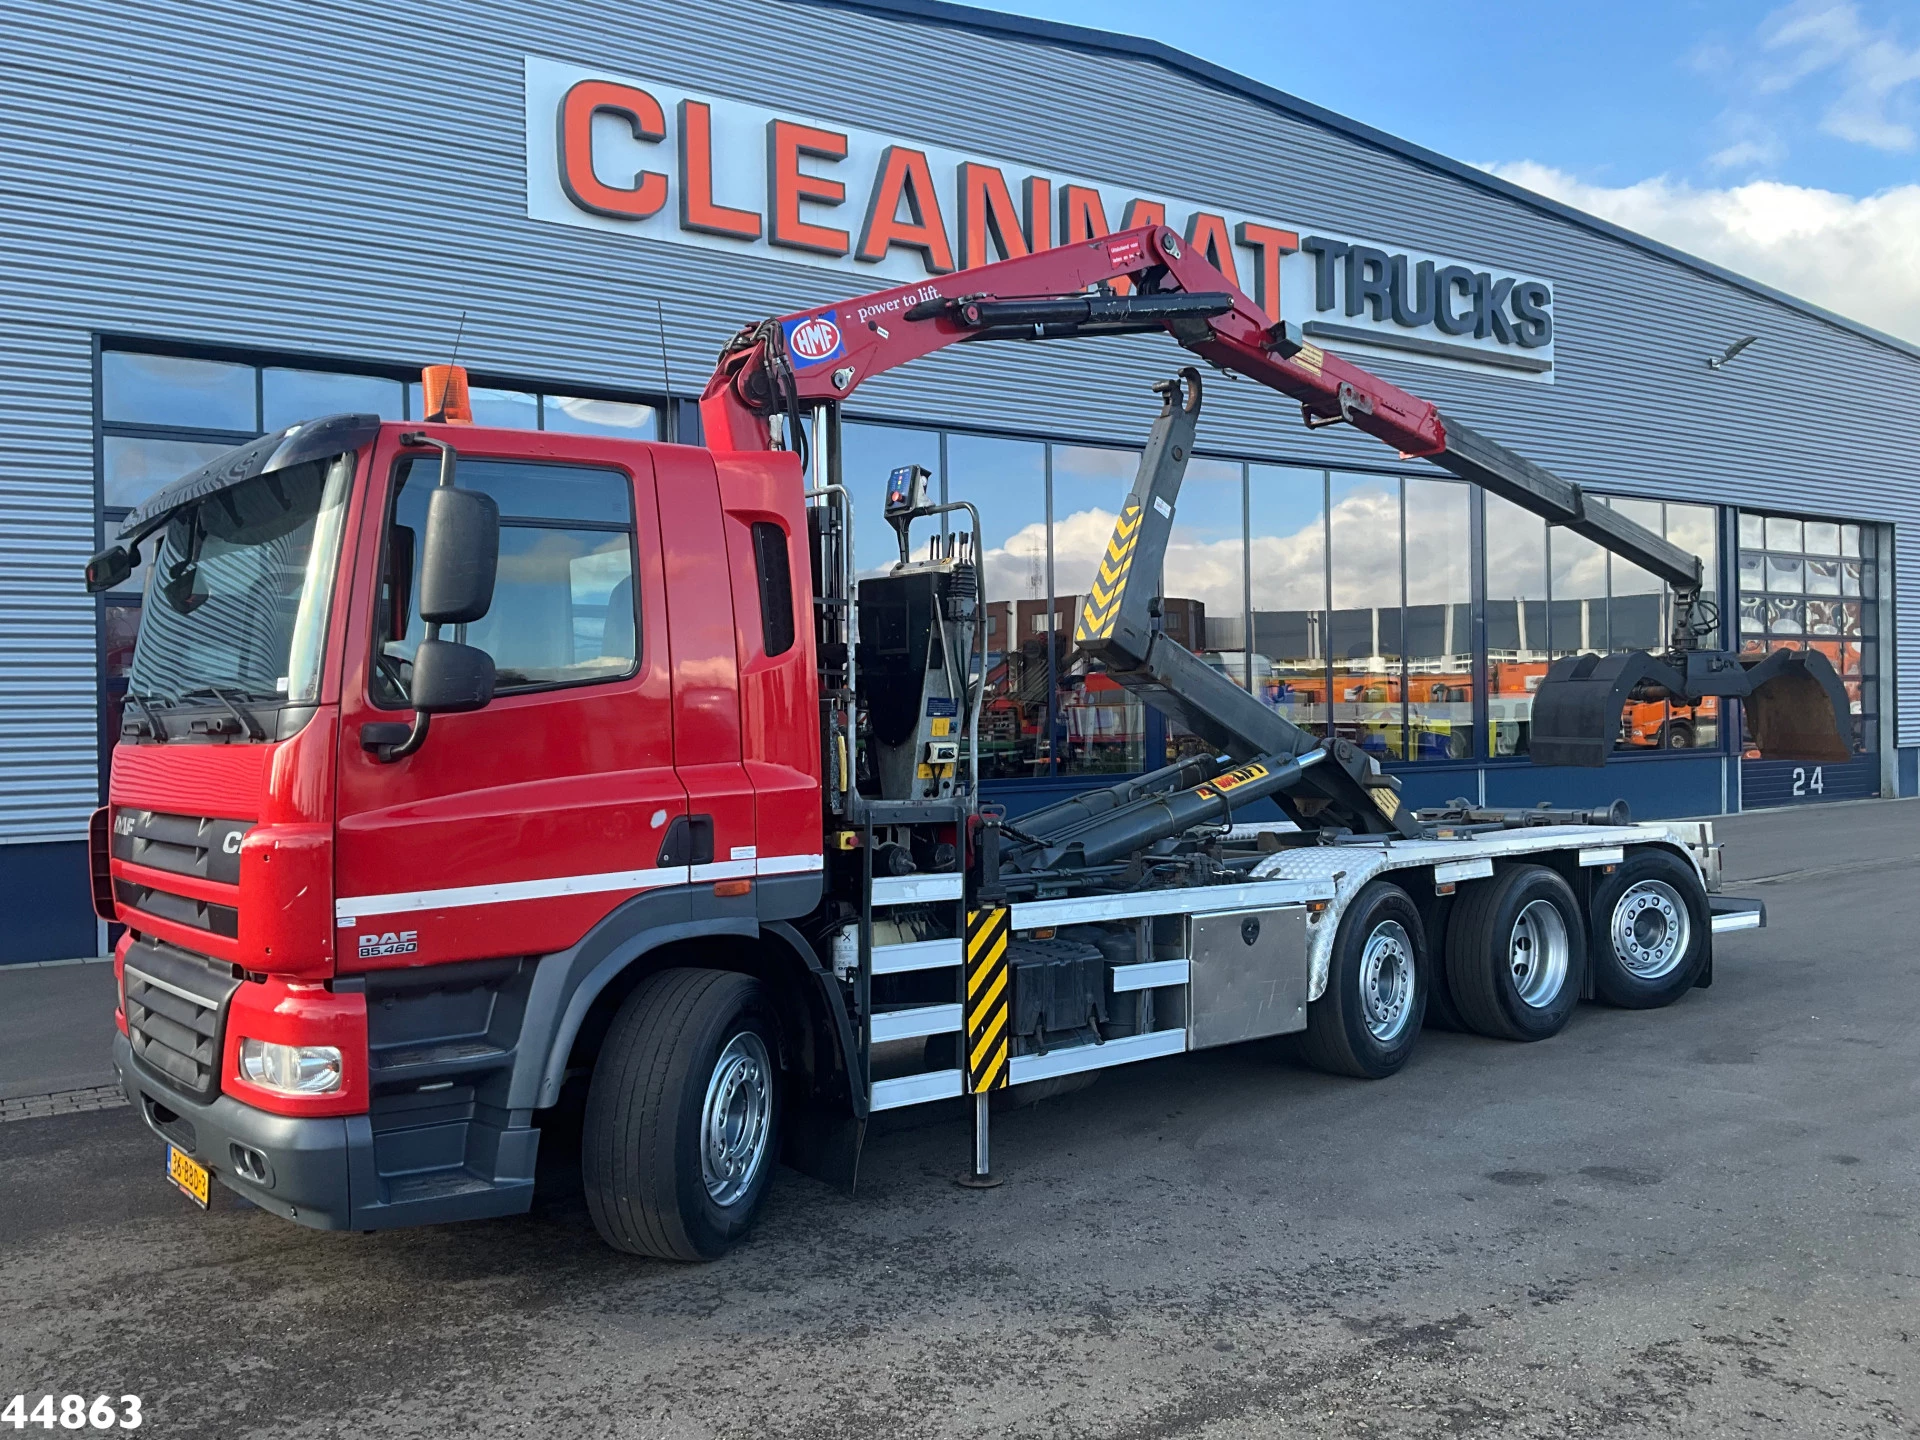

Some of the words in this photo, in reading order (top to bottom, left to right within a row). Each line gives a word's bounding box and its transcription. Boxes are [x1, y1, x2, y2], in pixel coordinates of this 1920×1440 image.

[1302, 235, 1552, 349] TRUCKS
[858, 299, 899, 323] power
[902, 294, 917, 307] to
[796, 323, 832, 354] HMF
[1792, 766, 1824, 796] 24
[113, 815, 135, 836] DAF
[222, 831, 245, 854] C
[359, 930, 418, 947] DAF
[360, 943, 416, 957] 85.460
